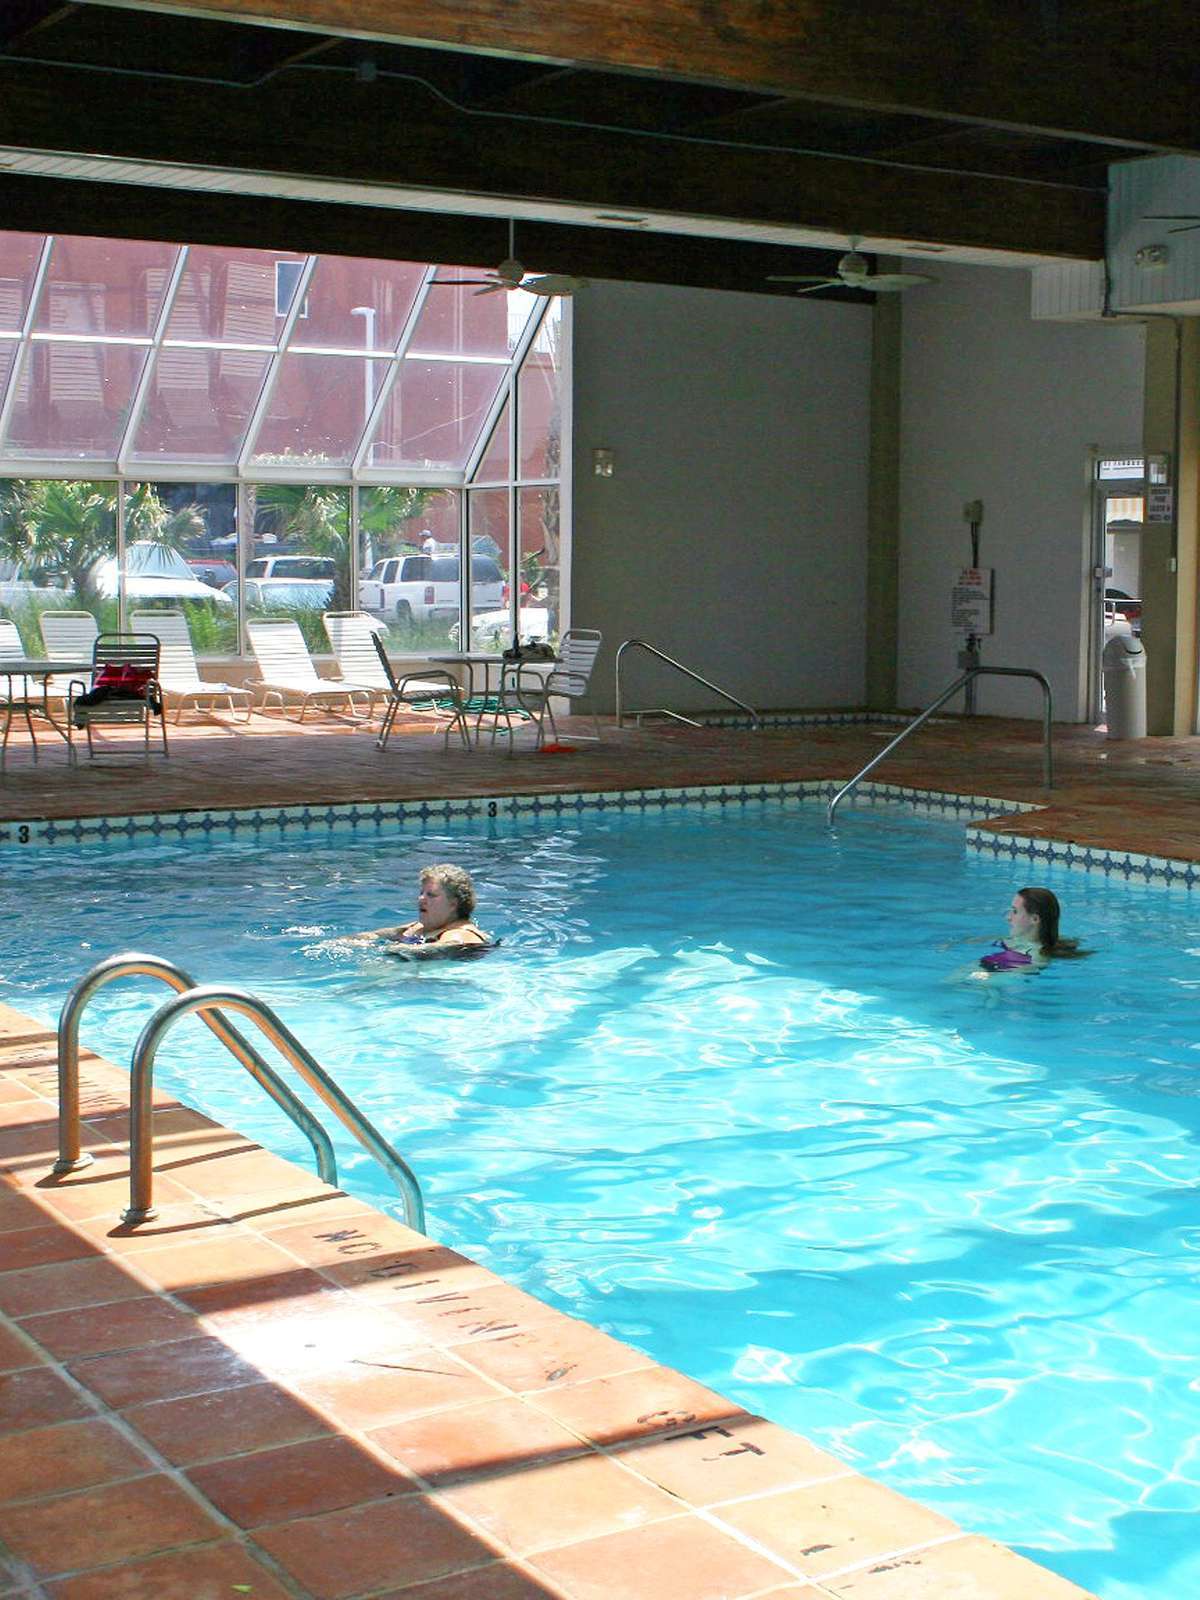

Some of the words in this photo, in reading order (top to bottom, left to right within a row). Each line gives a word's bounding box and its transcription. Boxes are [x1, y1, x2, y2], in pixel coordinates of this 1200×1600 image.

[488, 801, 498, 817] 3
[19, 825, 29, 844] 3
[312, 1229, 382, 1255] NO
